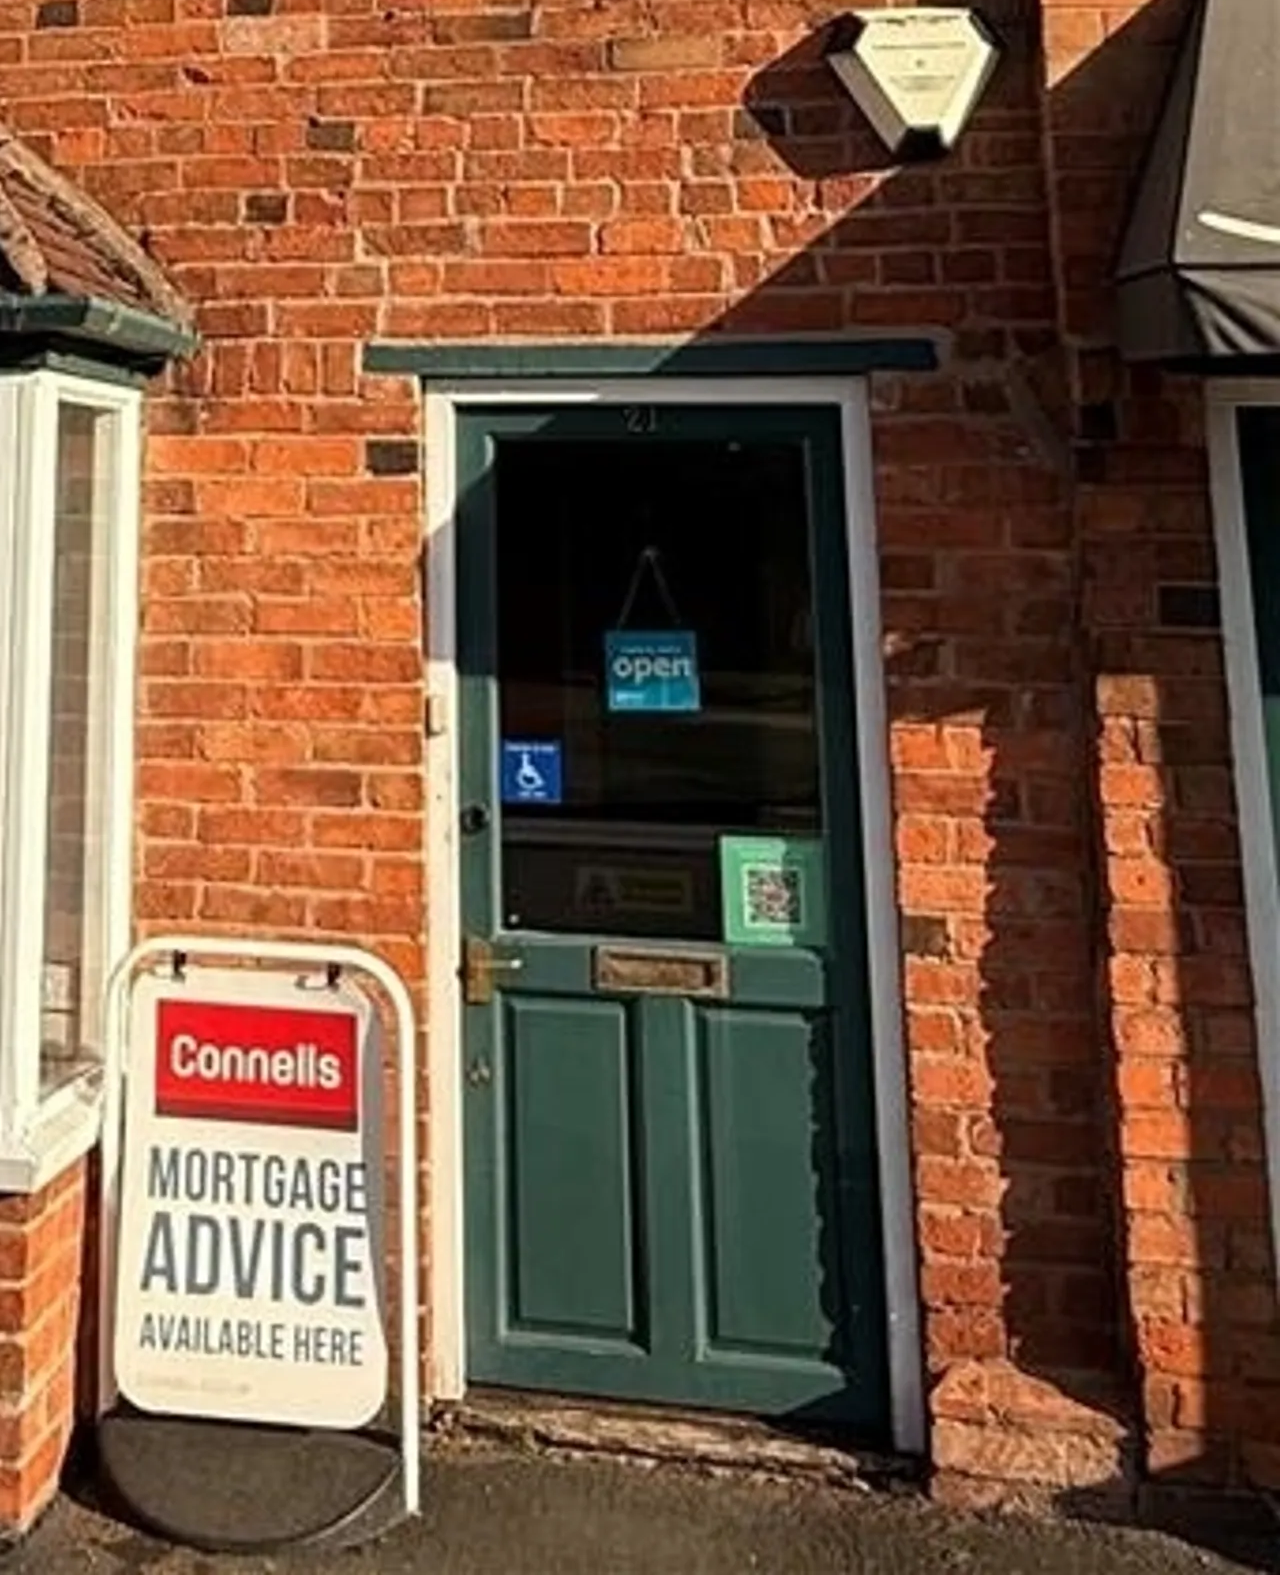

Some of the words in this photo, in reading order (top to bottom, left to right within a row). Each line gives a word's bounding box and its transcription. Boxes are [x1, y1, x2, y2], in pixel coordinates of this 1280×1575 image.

[612, 655, 691, 686] open
[170, 1033, 343, 1090] Connells
[147, 1145, 368, 1214] MORTGAGE
[139, 1210, 367, 1308] ADVICE
[139, 1311, 285, 1361] AVAILABLE
[293, 1323, 364, 1367] HERE
